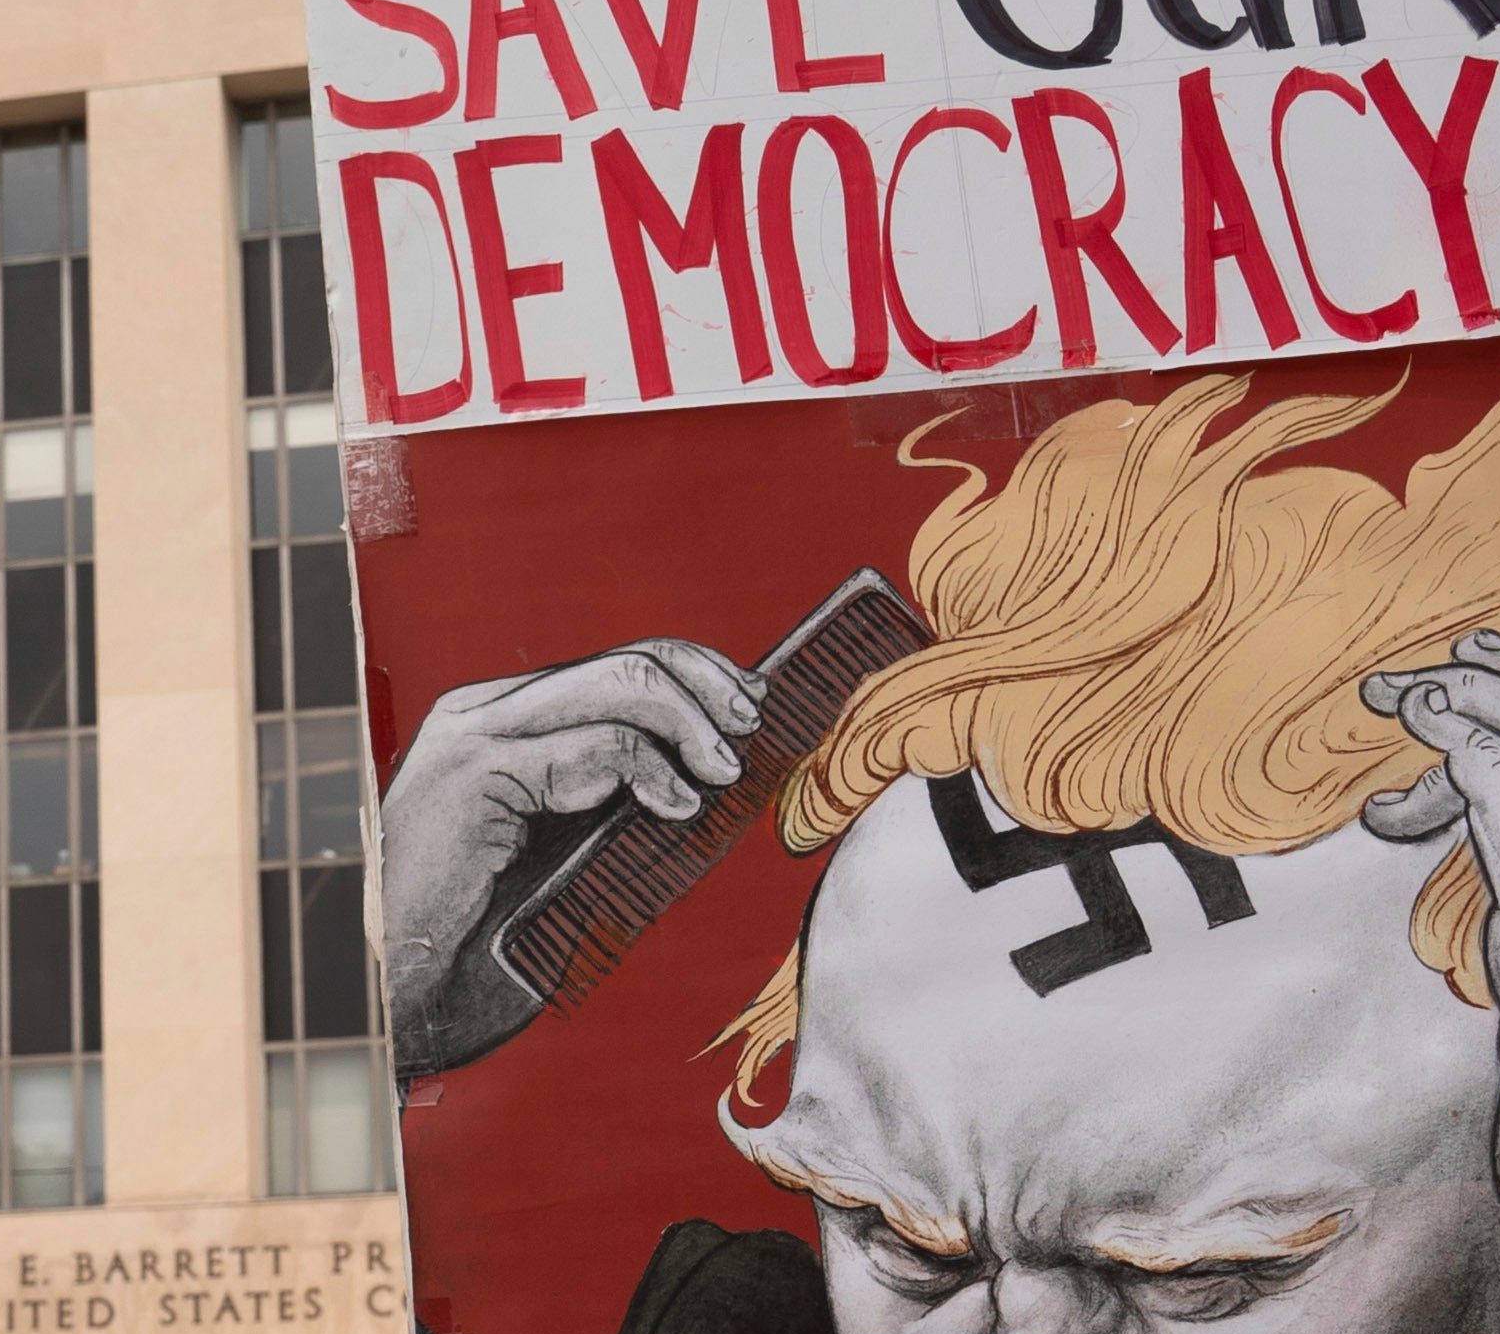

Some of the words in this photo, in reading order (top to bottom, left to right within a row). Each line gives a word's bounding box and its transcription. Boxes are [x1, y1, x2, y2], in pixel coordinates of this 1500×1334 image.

[20, 1253, 50, 1287] E.
[73, 1244, 290, 1286] BARRETT
[159, 1287, 323, 1327] STATES
[366, 1283, 407, 1318] C
